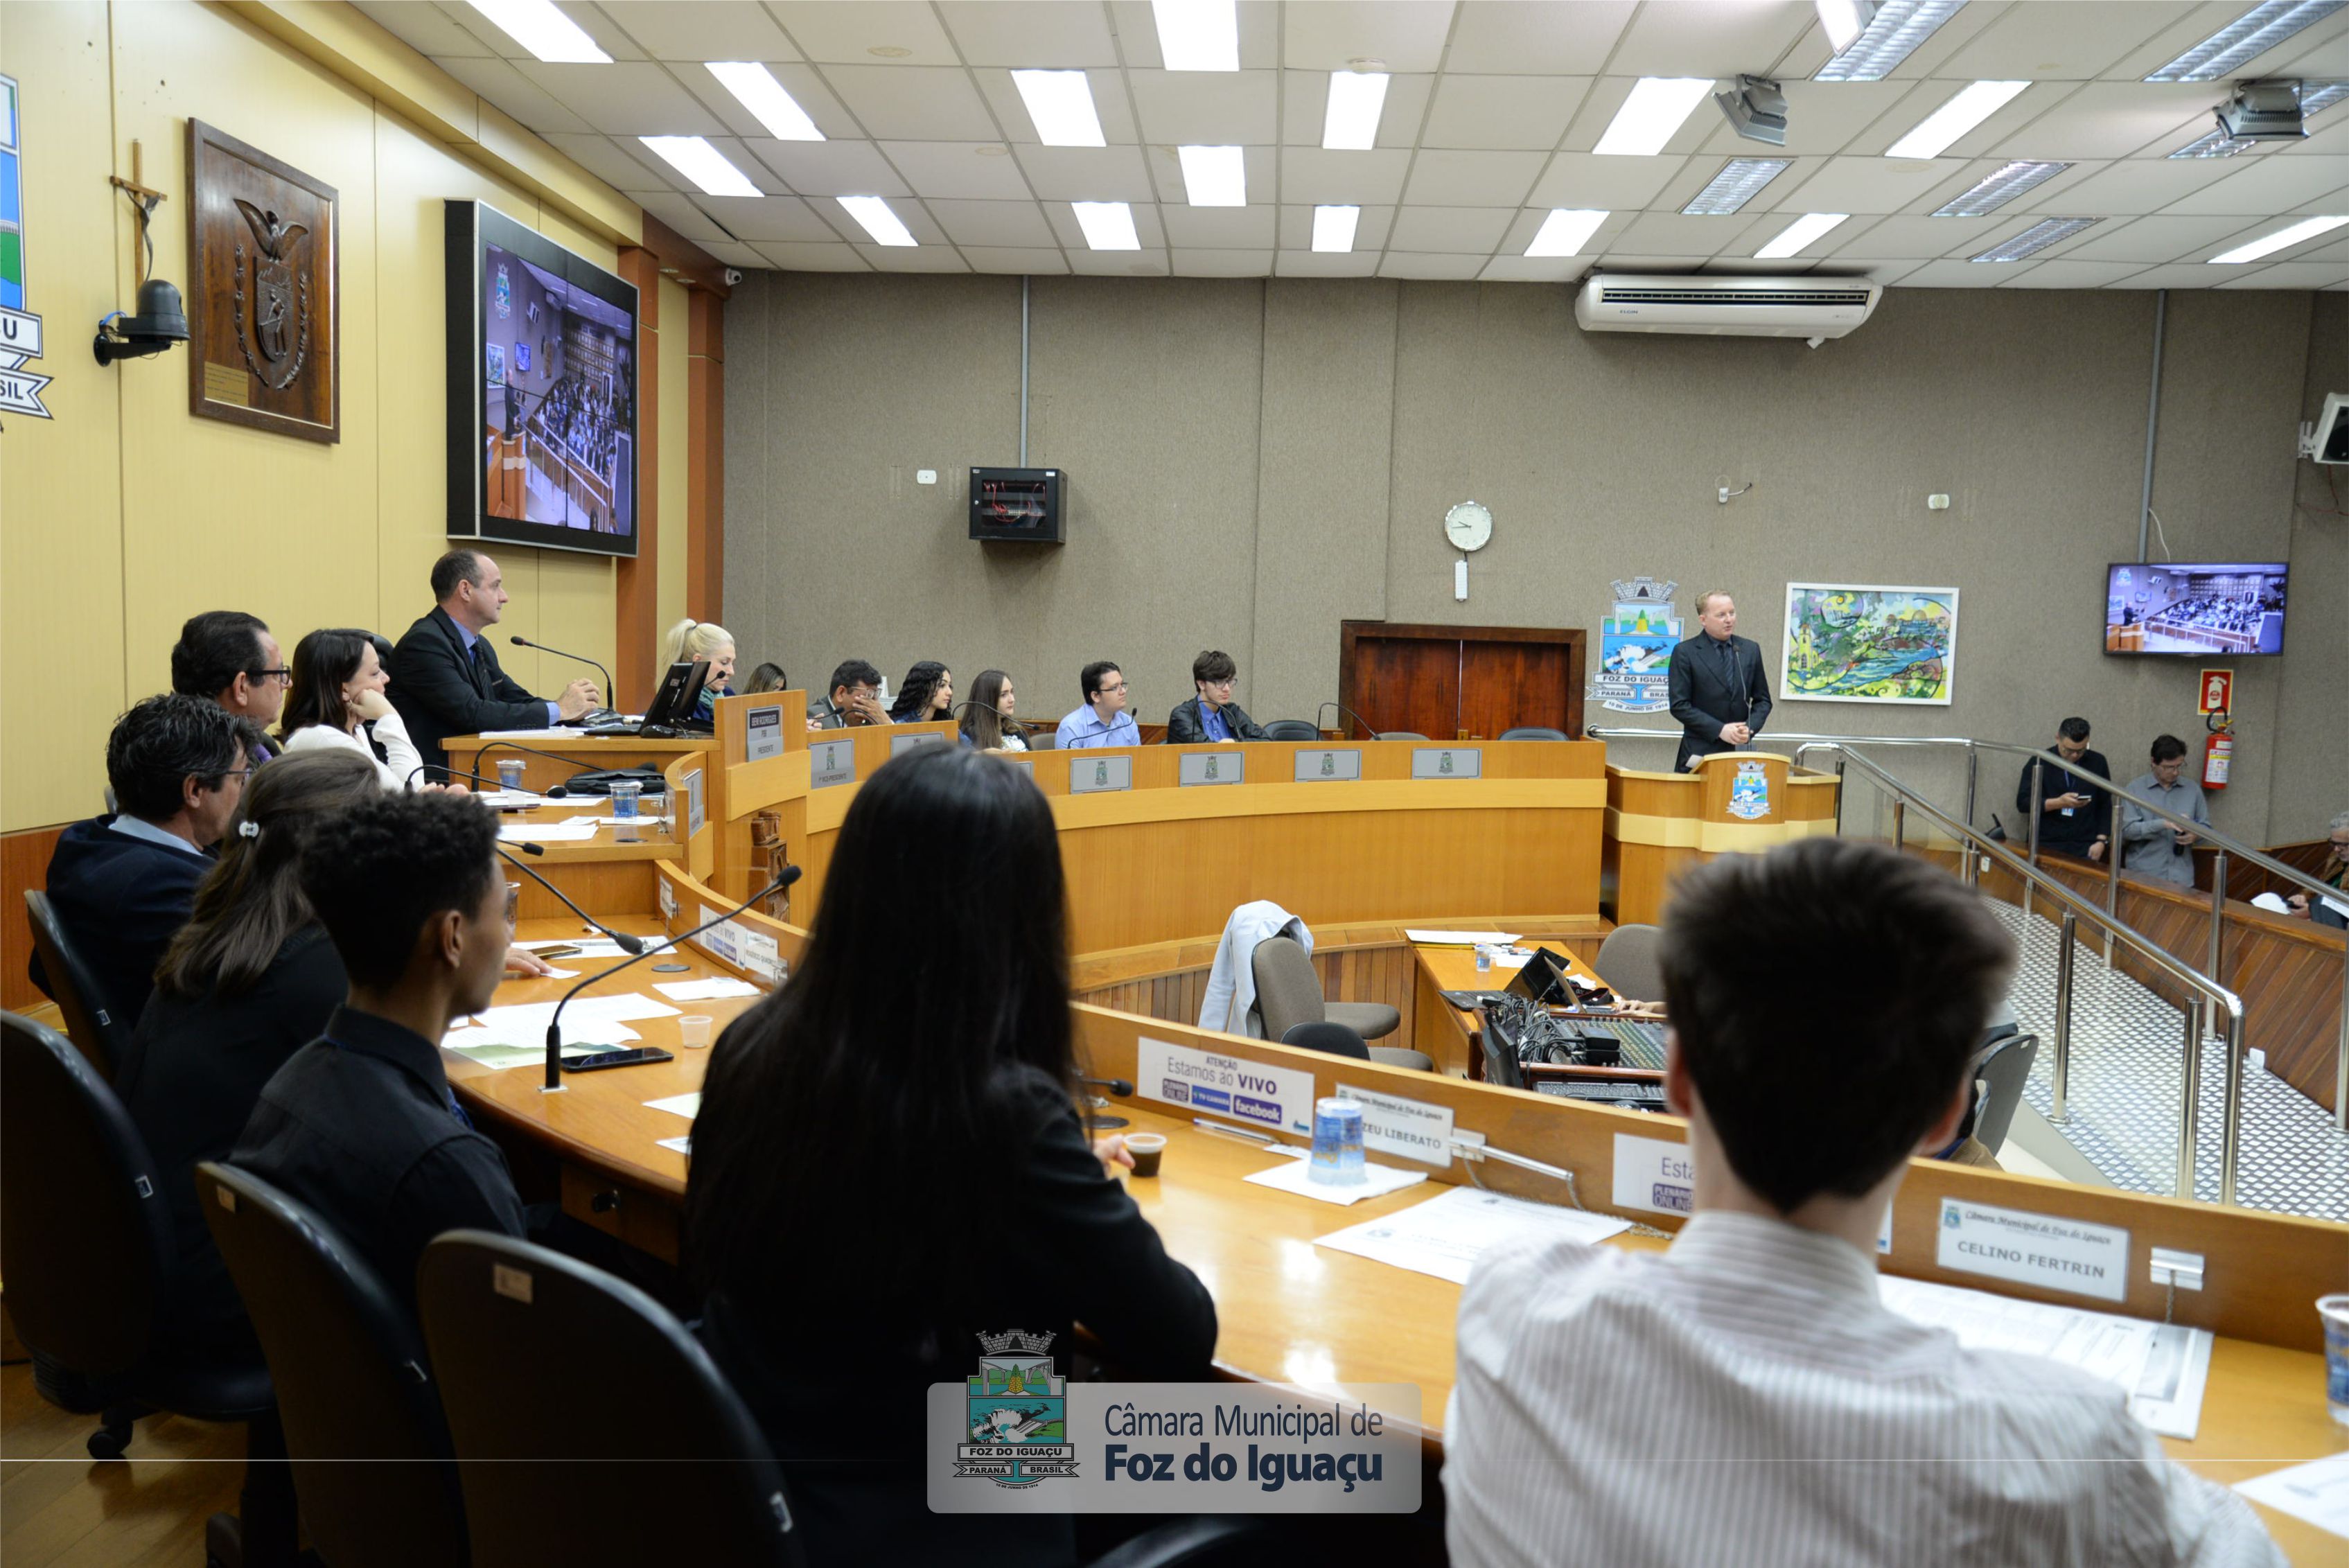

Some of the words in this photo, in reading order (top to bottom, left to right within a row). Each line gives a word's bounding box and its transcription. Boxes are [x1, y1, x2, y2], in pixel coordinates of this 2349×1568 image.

[0, 380, 24, 400] SIL
[1168, 1056, 1215, 1083] Estamos
[1220, 1073, 1233, 1086] ao
[1238, 1074, 1276, 1095] VIVO
[1206, 1056, 1238, 1071] ATENÇÃO
[1236, 1099, 1280, 1121] facebook
[1362, 1122, 1382, 1135] ZEU
[1384, 1127, 1441, 1150] LIBERATO
[1662, 1157, 1694, 1180] Esta
[1965, 1210, 1995, 1224] Câmara
[1996, 1216, 2038, 1231] Municipal
[2040, 1222, 2050, 1232] de
[2051, 1226, 2068, 1237] Foz
[1958, 1241, 2022, 1262] CELINO
[2027, 1253, 2105, 1278] FERTRIN
